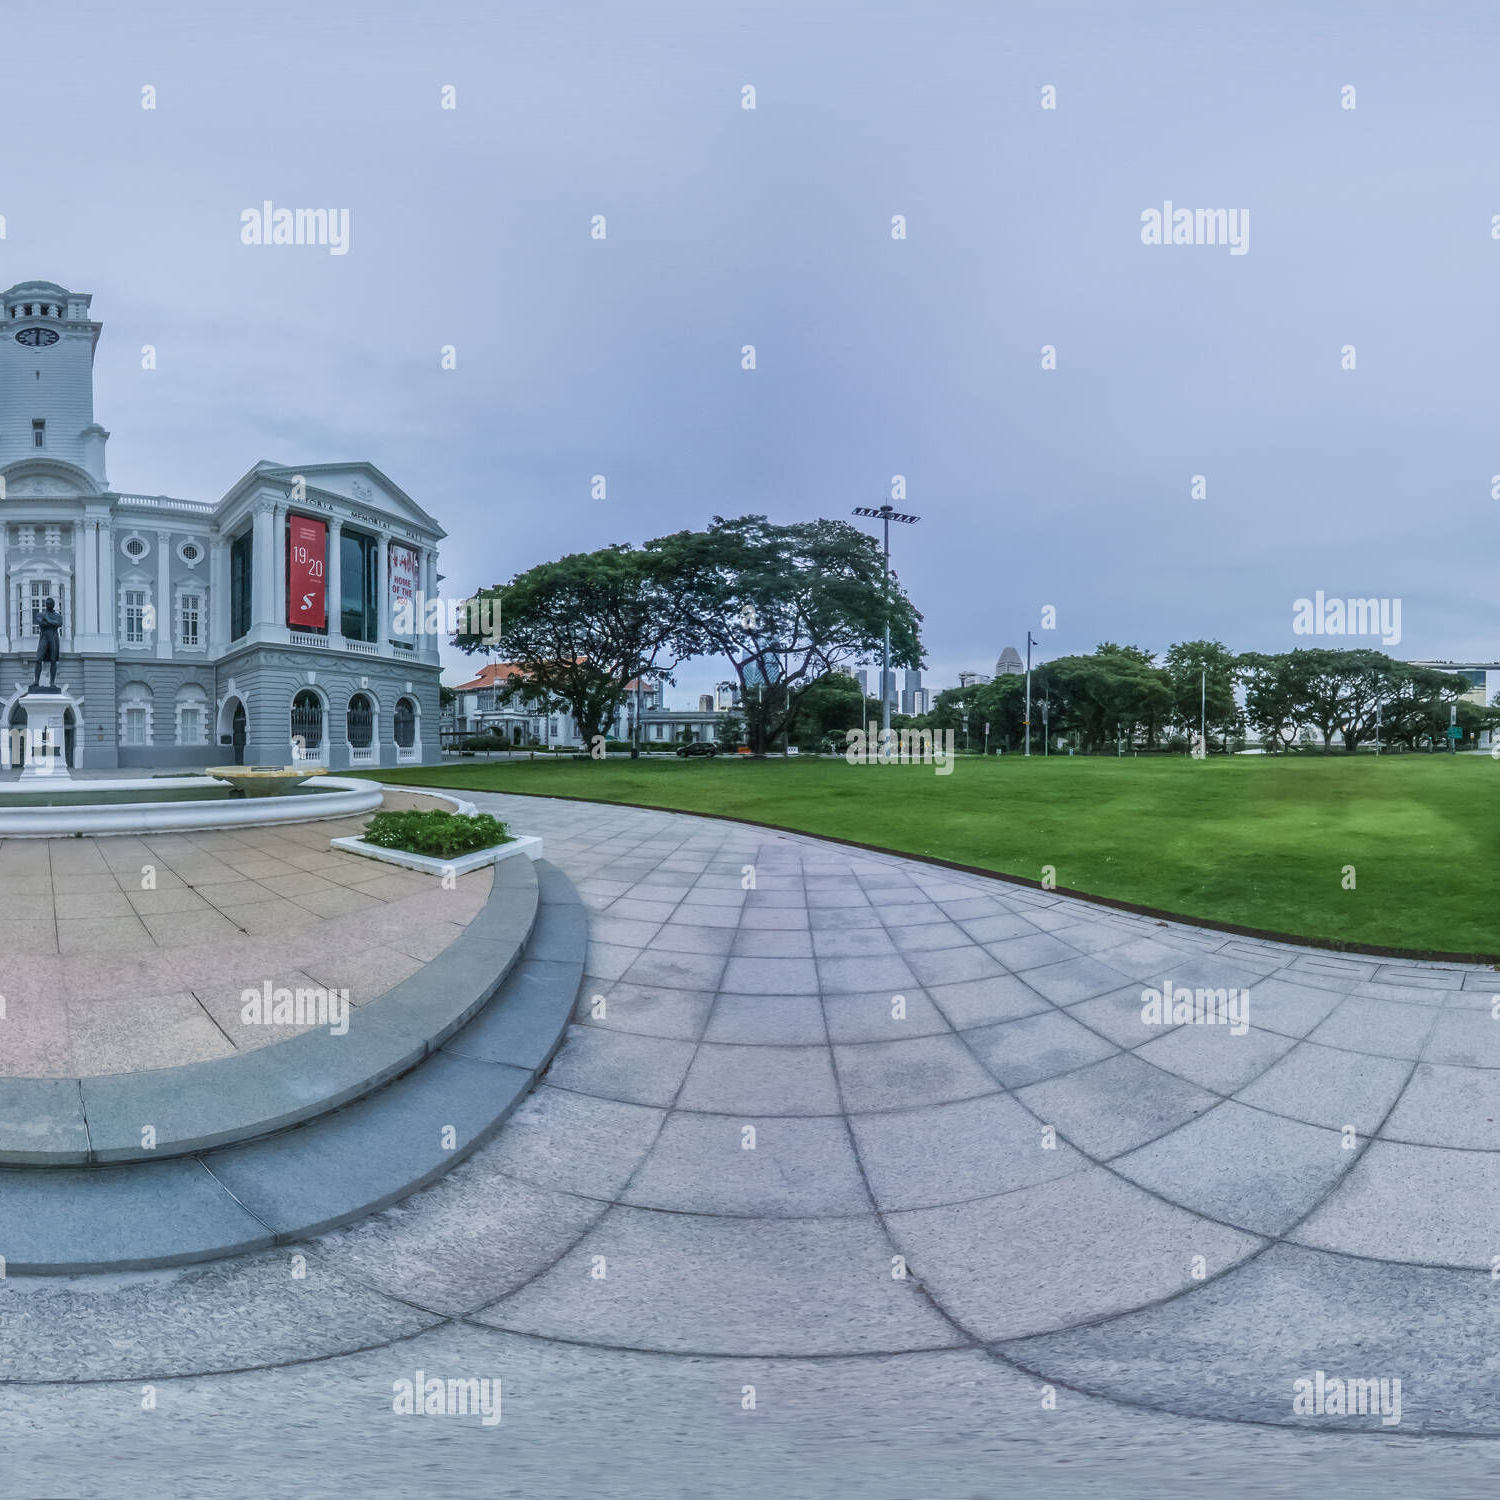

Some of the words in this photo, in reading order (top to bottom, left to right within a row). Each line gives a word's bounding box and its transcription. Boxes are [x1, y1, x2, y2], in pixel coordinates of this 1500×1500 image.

[285, 491, 333, 511] VTORIA
[294, 546, 306, 564] 19
[308, 558, 323, 577] 20
[392, 585, 400, 594] OF
[402, 587, 412, 597] THE
[394, 576, 412, 588] HOME
